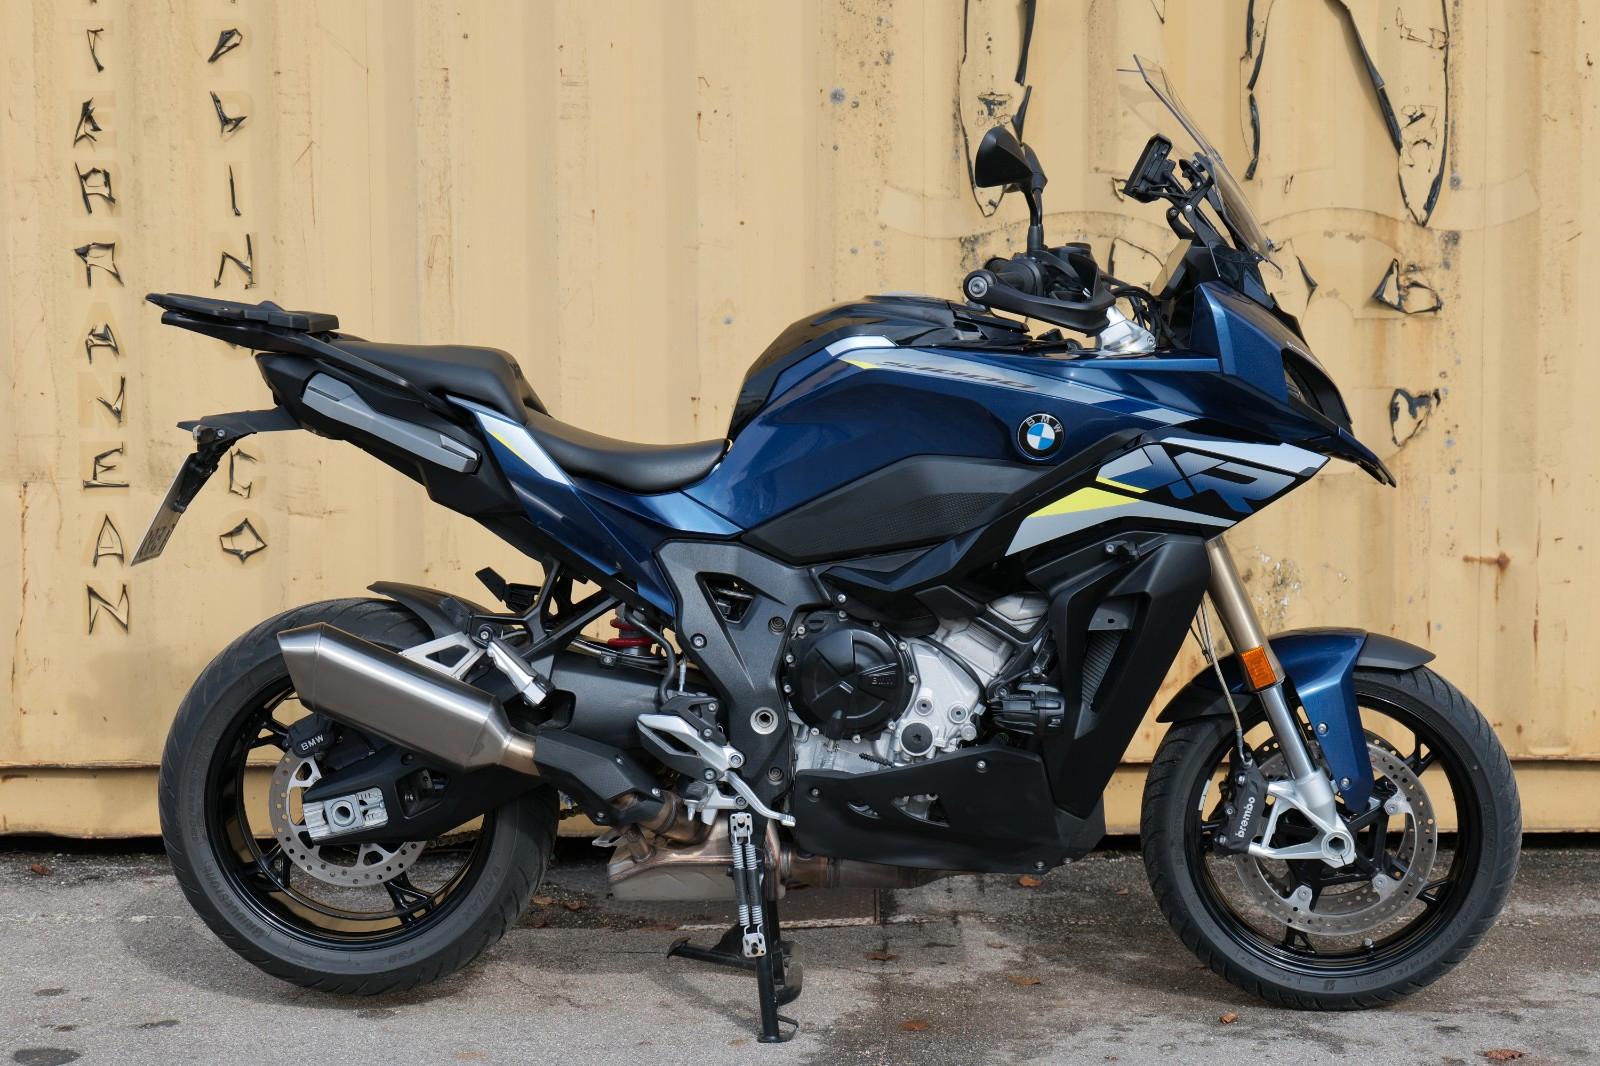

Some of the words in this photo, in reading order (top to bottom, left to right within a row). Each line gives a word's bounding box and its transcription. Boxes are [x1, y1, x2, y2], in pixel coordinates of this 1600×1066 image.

[1025, 415, 1064, 433] BMW
[300, 734, 325, 751] BMW
[1234, 796, 1256, 838] brembo
